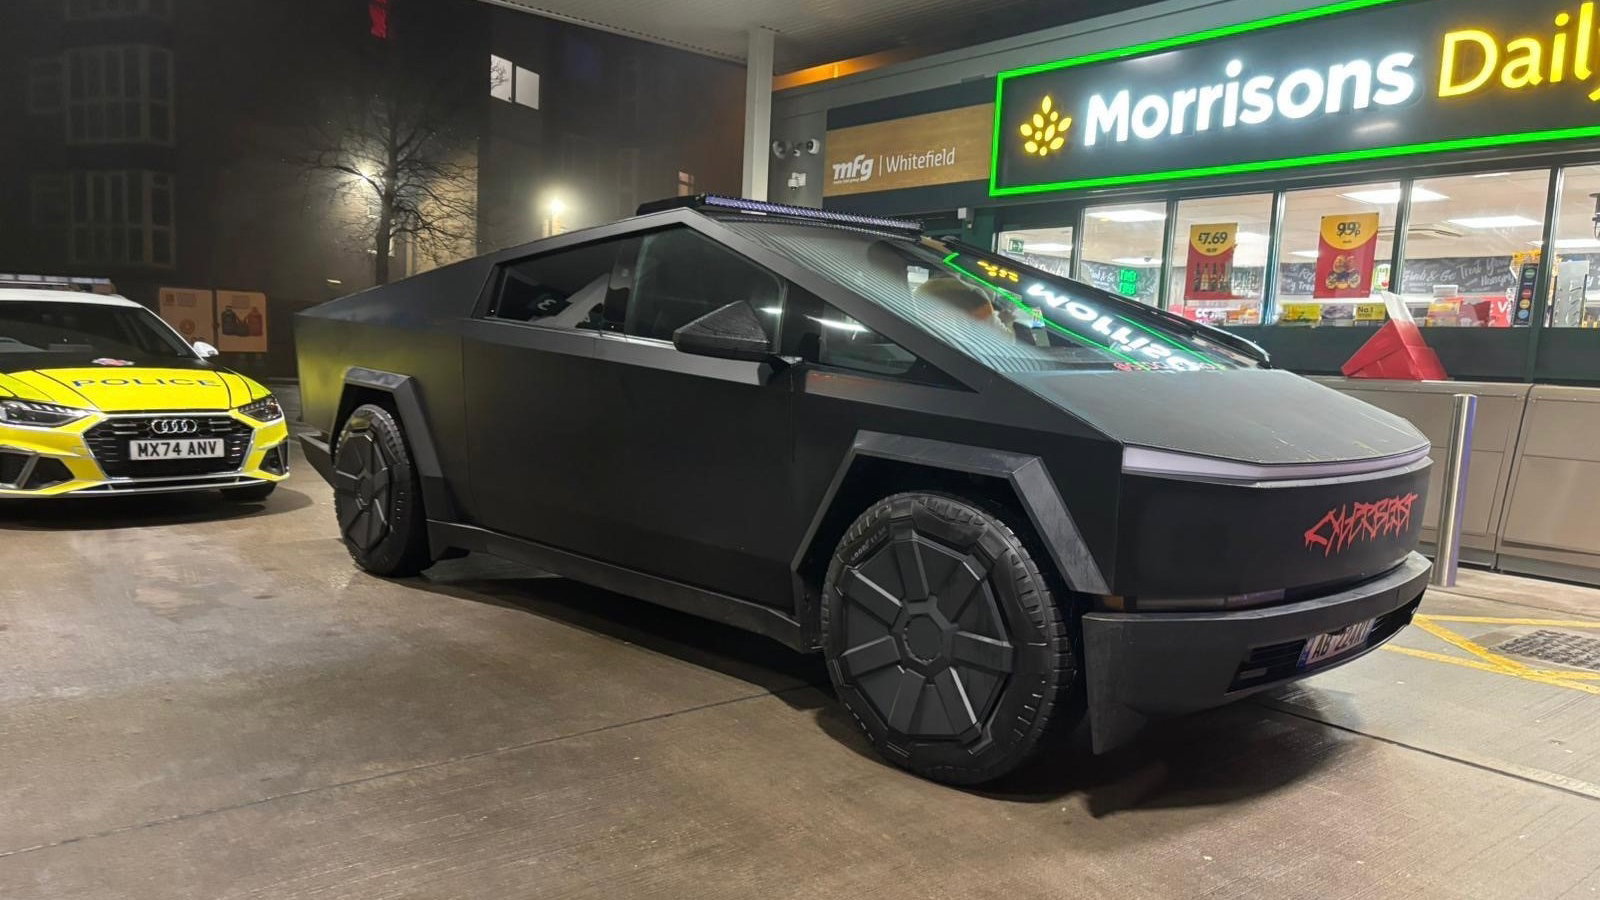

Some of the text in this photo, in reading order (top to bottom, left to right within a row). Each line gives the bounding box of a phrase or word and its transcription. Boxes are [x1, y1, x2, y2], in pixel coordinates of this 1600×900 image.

[1084, 2, 1600, 147] Morrisons Dail
[832, 147, 956, 182] mfg Whitefield
[1336, 221, 1361, 237] 99p
[1198, 231, 1228, 245] £7.69
[71, 377, 222, 389] POLICE
[137, 440, 218, 458] MX74 ANV
